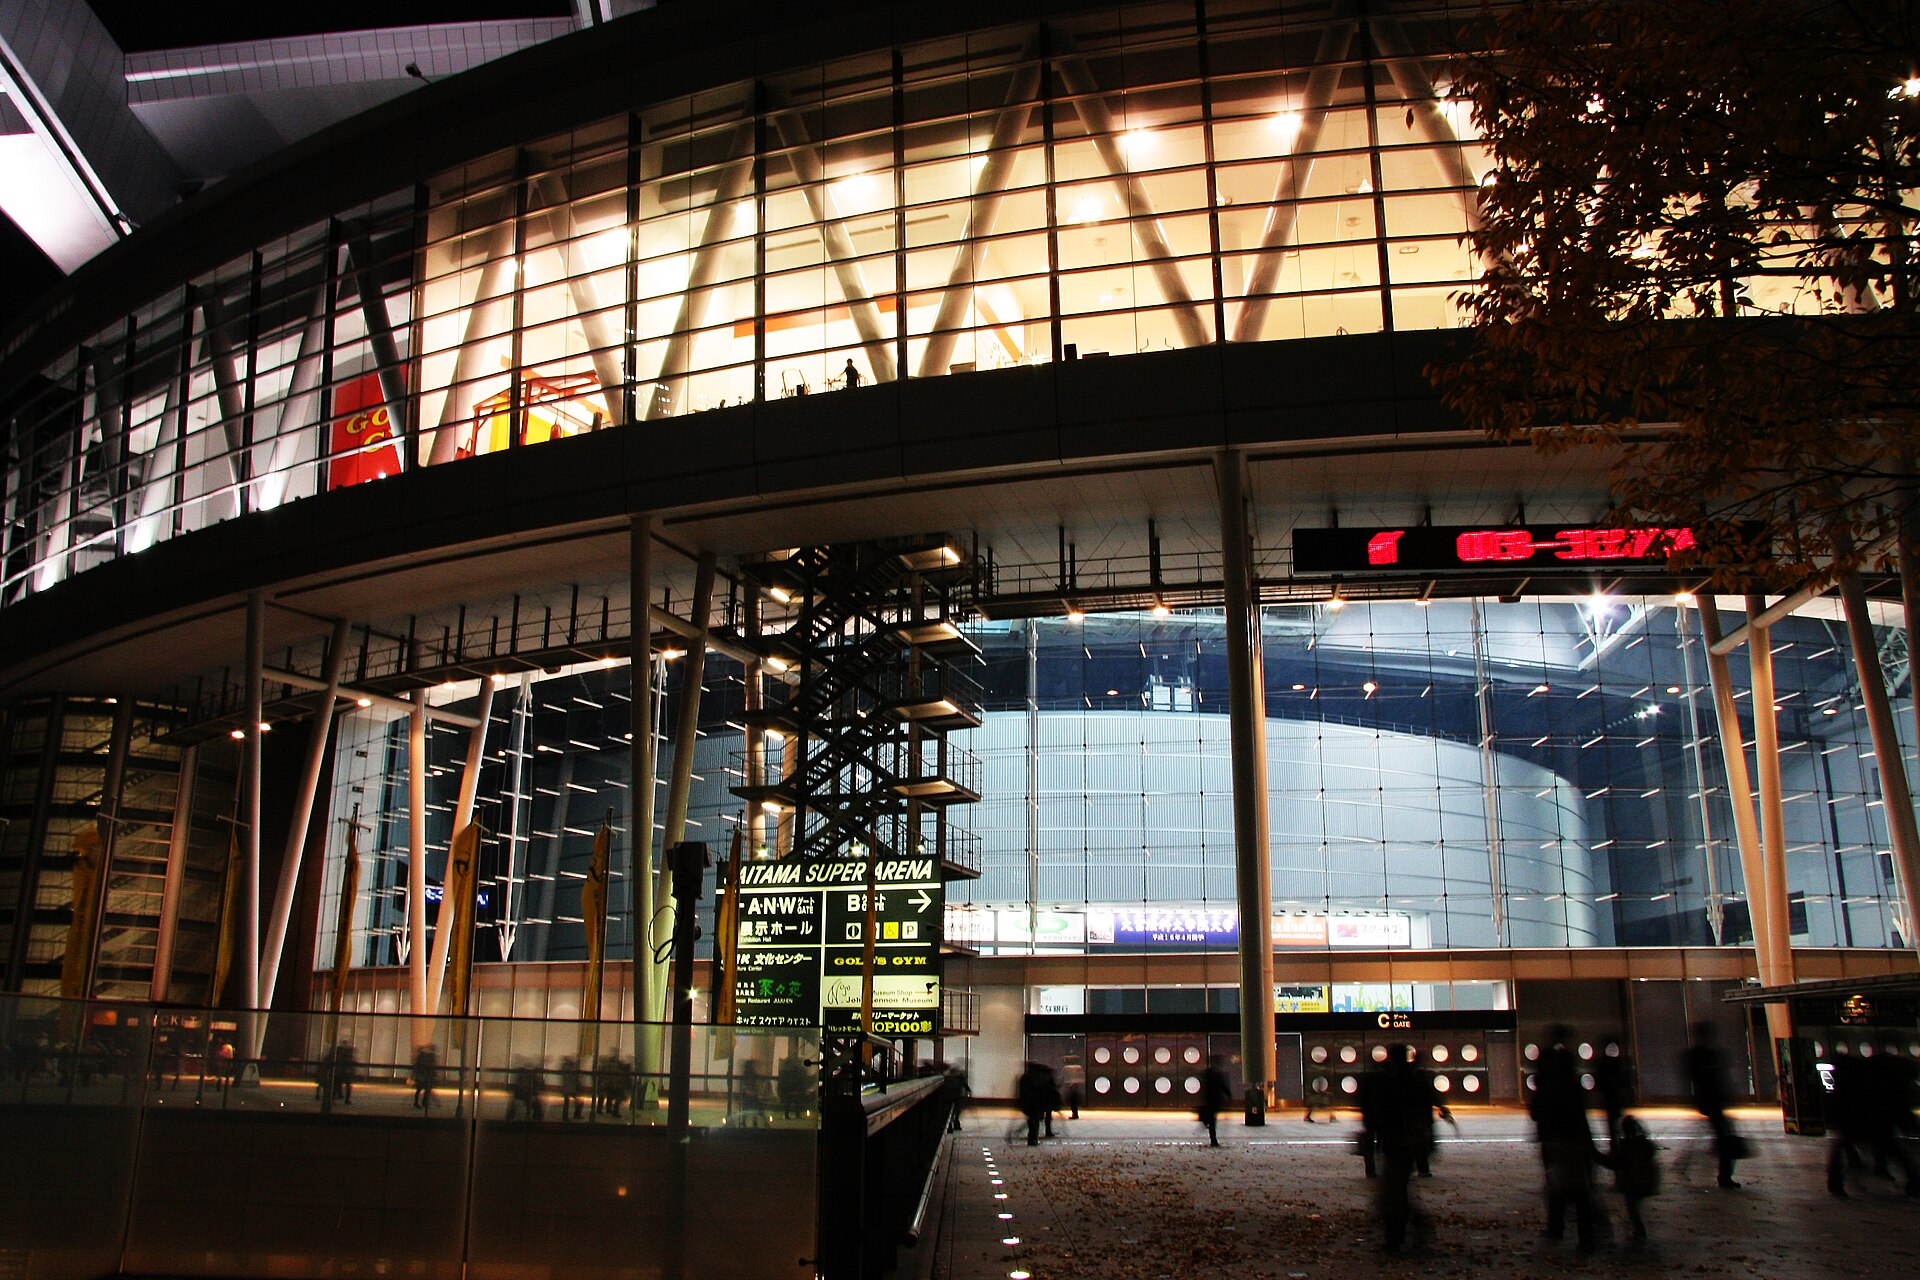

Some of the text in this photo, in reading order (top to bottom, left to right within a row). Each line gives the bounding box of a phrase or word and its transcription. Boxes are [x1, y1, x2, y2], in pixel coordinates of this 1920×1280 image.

[724, 860, 933, 885] AITAMA SUPER ARENA
[797, 905, 814, 915] GATE
[847, 894, 860, 912] B
[740, 921, 814, 936] 展示ホール
[753, 952, 813, 966] 文化センター
[892, 956, 927, 966] GYM
[1377, 1013, 1391, 1029] C
[1393, 1020, 1411, 1028] GATE
